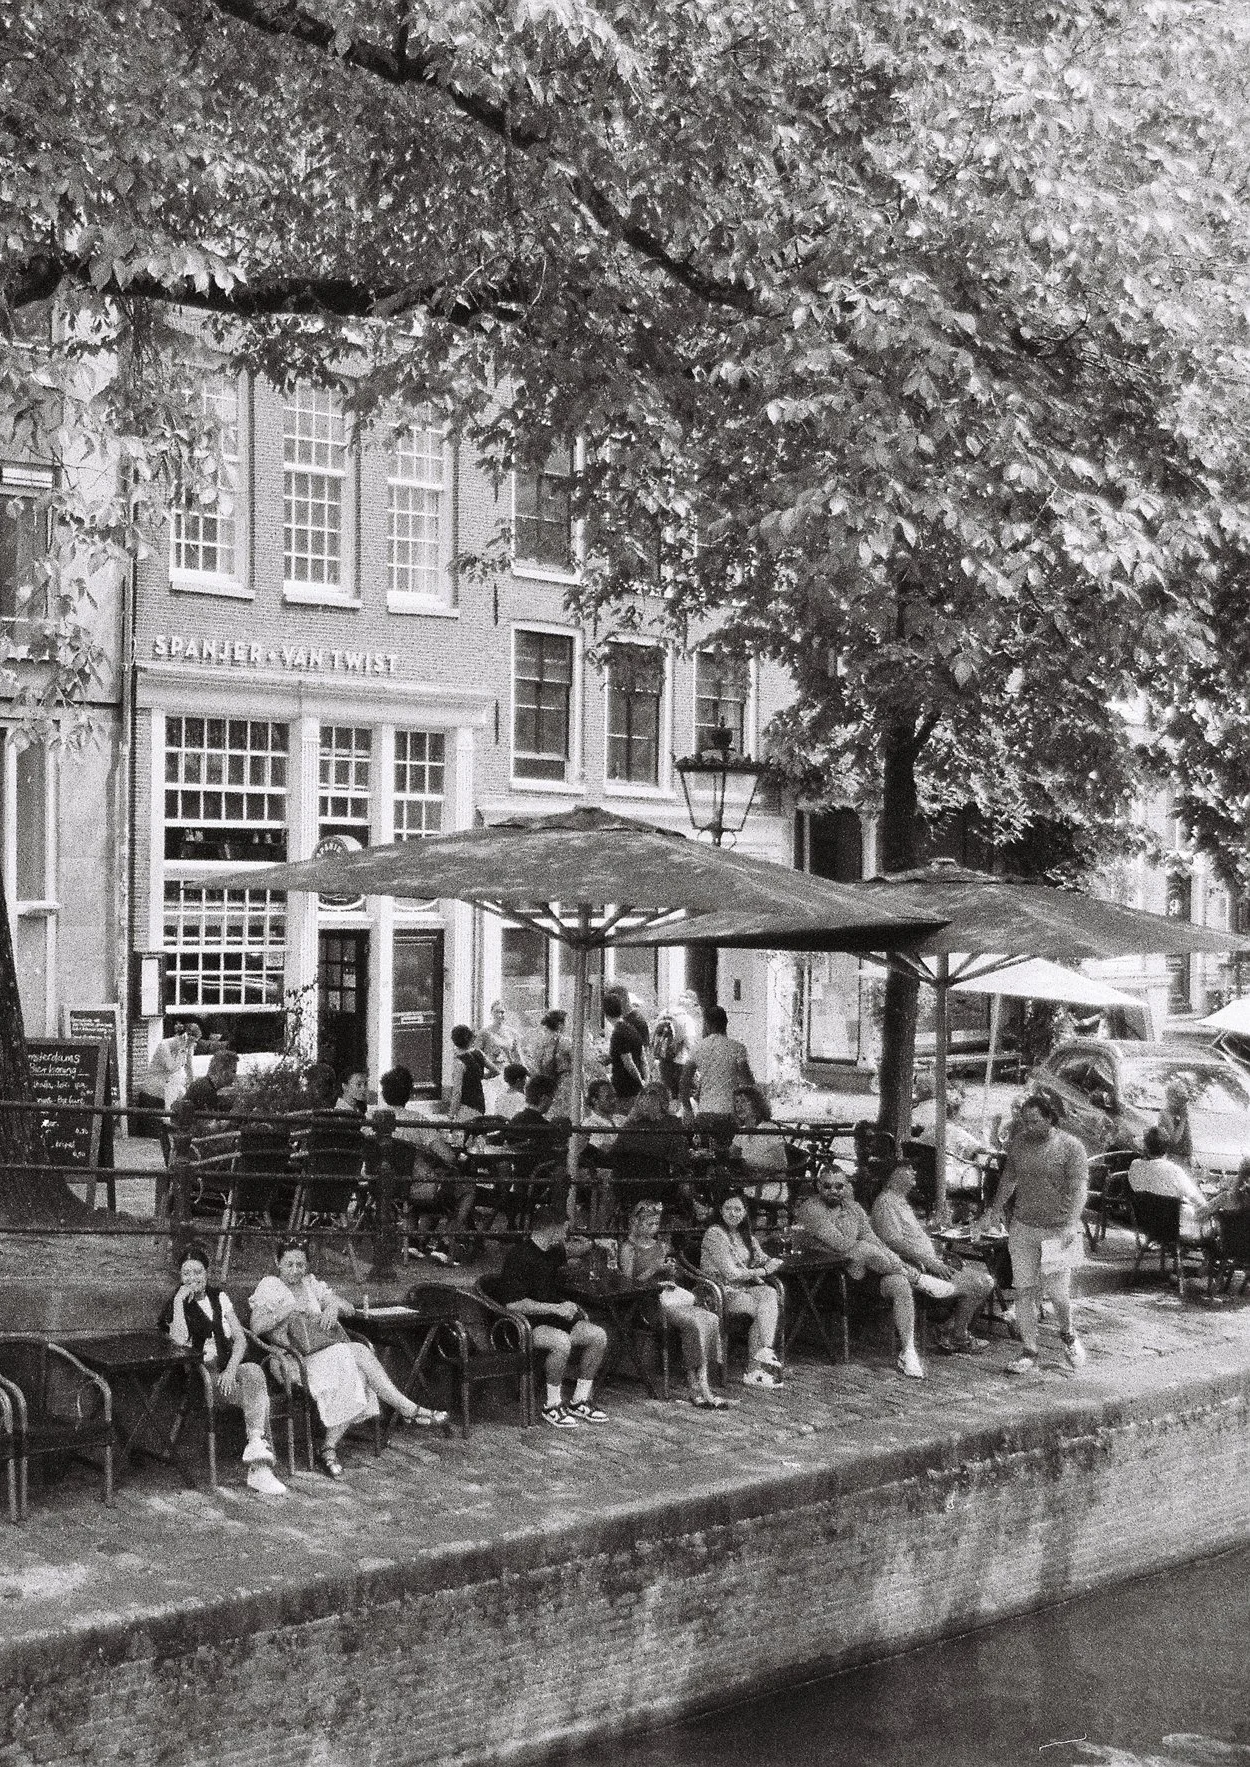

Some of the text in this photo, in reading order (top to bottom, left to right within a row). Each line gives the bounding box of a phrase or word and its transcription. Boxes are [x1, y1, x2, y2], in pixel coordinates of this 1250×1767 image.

[154, 634, 399, 673] SPANJER VAN TWIST
